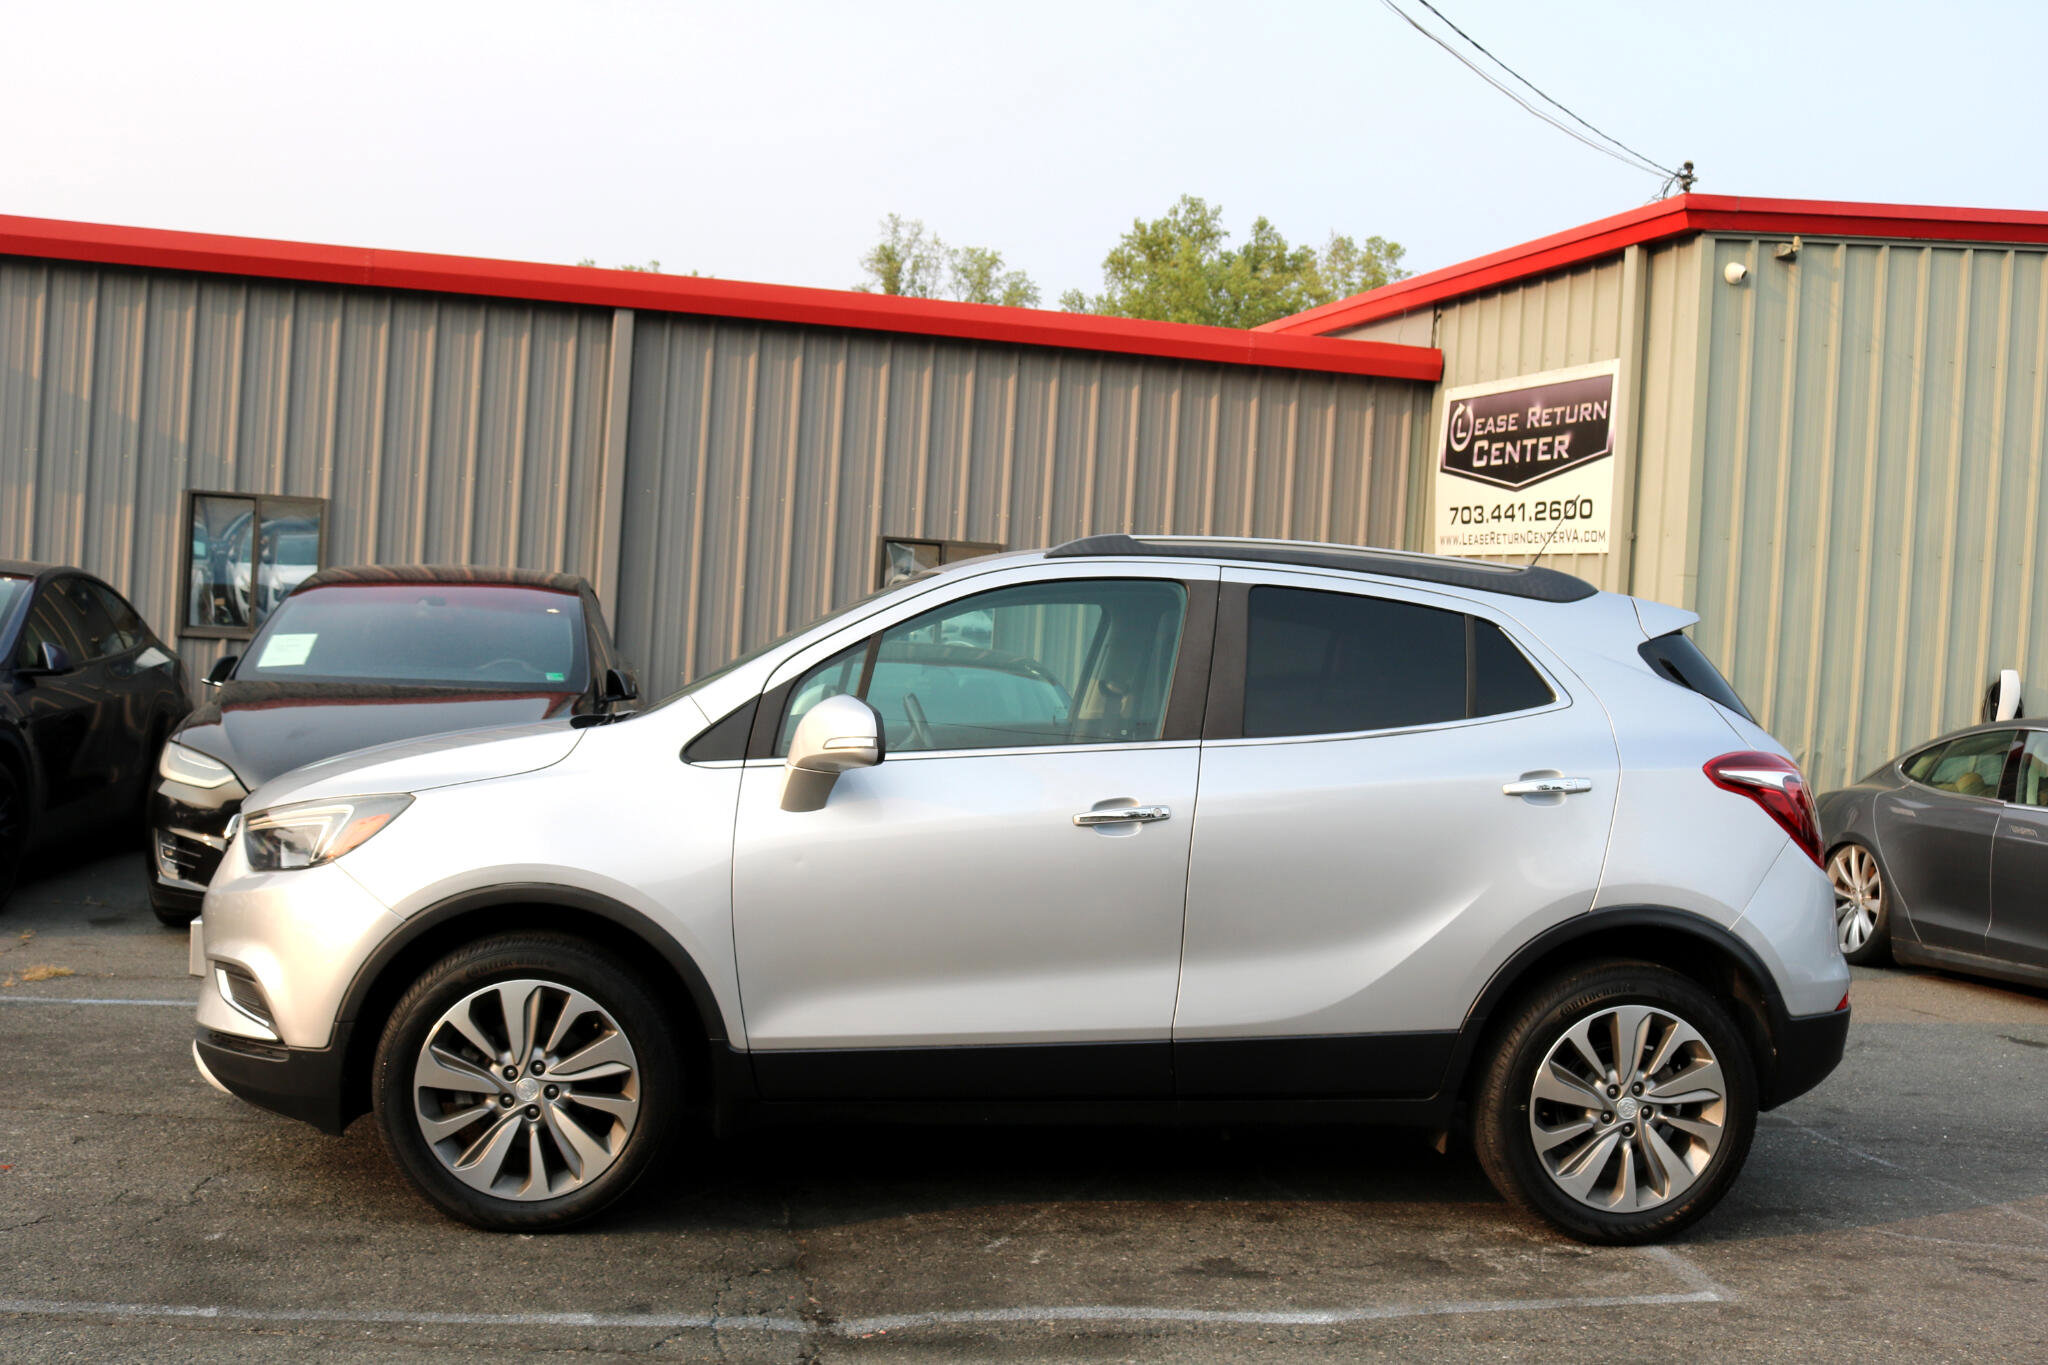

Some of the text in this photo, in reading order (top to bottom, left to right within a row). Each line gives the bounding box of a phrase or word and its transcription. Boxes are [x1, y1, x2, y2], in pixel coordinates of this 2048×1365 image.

[1526, 400, 1608, 430] RETURN
[1472, 434, 1571, 468] CENTER
[1449, 498, 1593, 525] 703.441.2600
